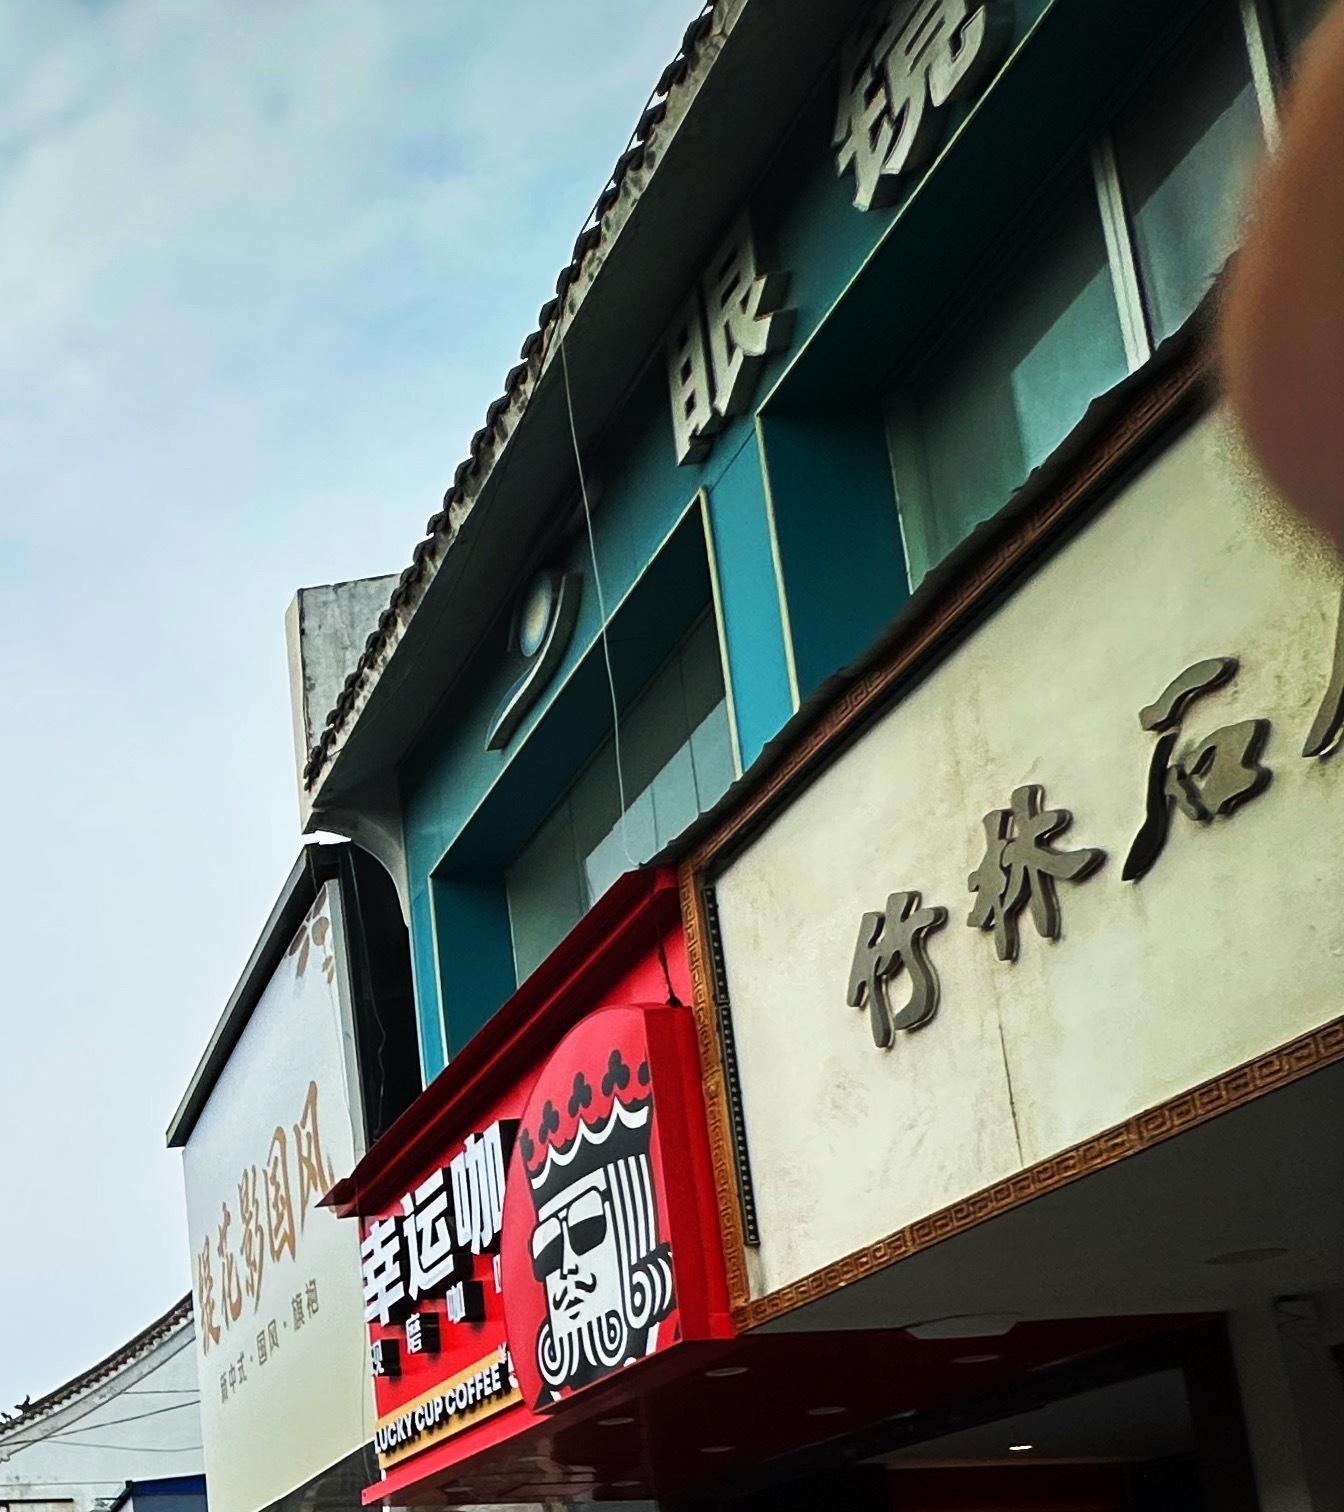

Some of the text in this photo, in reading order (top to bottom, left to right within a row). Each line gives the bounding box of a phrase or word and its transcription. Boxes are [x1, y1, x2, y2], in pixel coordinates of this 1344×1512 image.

[846, 570, 1344, 1050] 竹林石
[361, 1120, 506, 1327] 幸运咖
[373, 1413, 414, 1455] LUCKY
[414, 1395, 444, 1432] CUP
[444, 1362, 503, 1416] COFFEE
